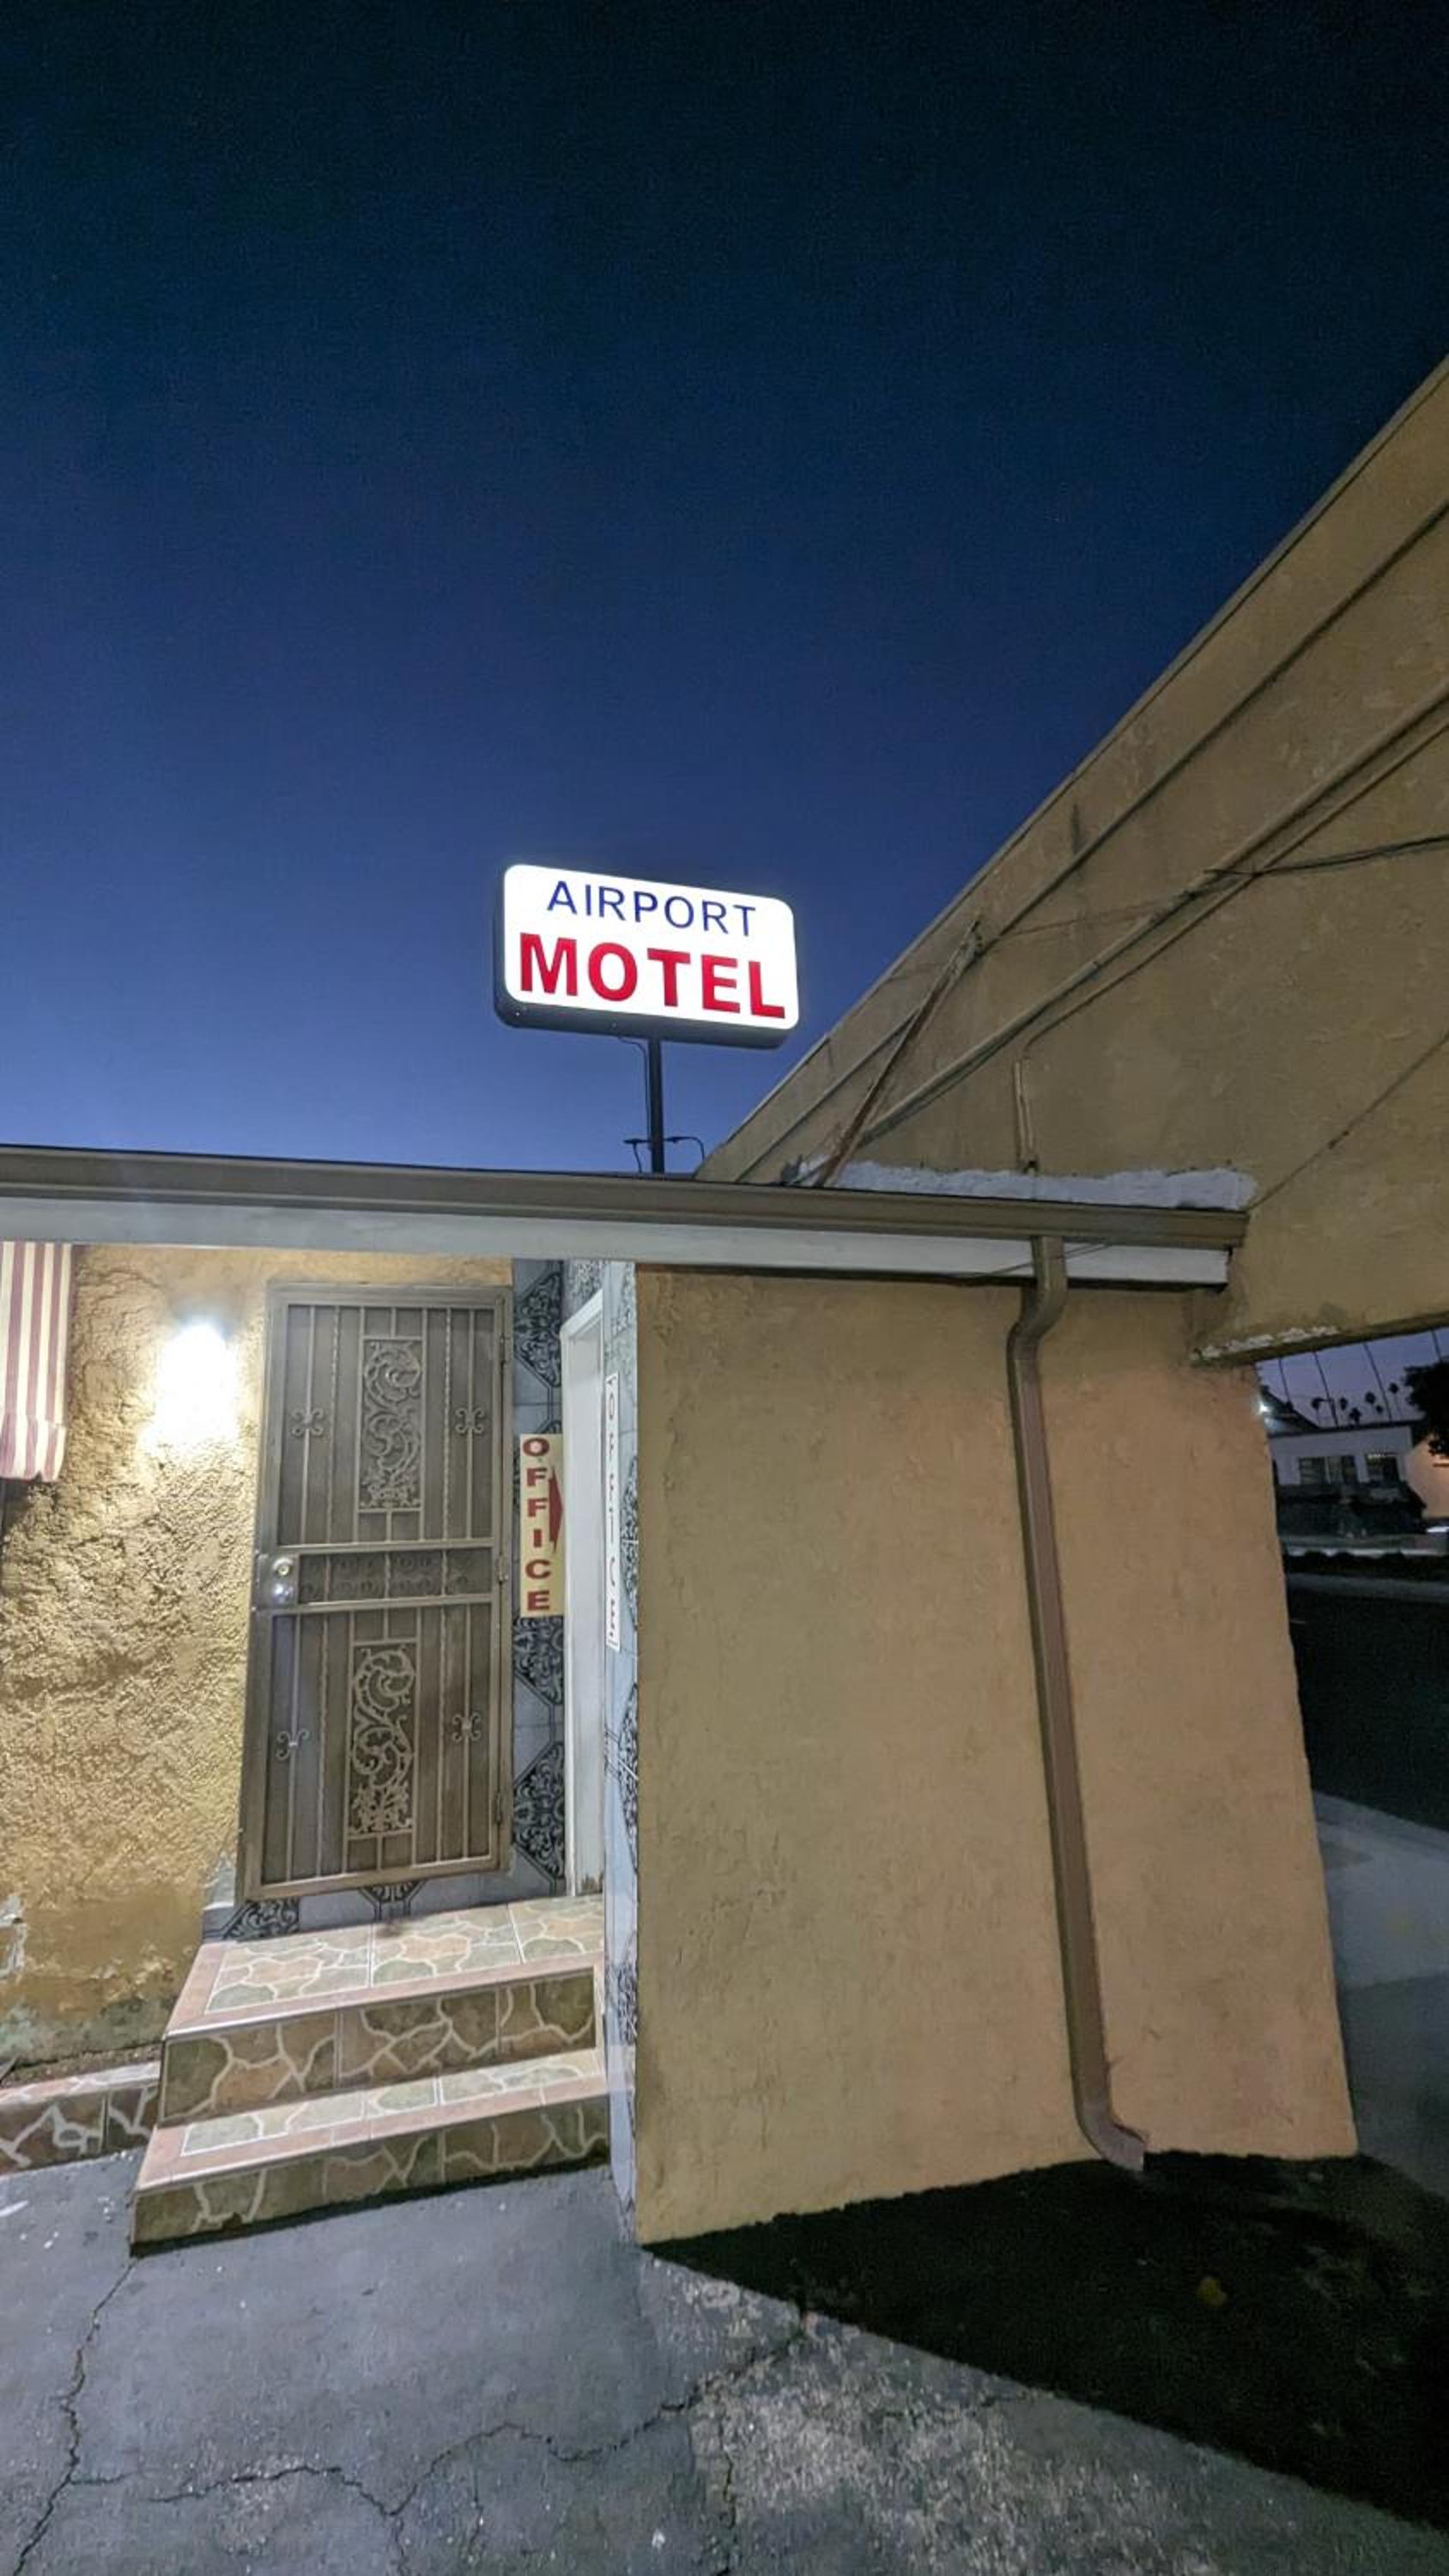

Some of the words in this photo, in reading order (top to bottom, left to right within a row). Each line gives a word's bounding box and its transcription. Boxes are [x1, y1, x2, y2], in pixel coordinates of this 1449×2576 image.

[547, 880, 756, 937] AIRPORT
[520, 933, 785, 1019] MOTEL
[523, 1437, 552, 1611] OFFICE
